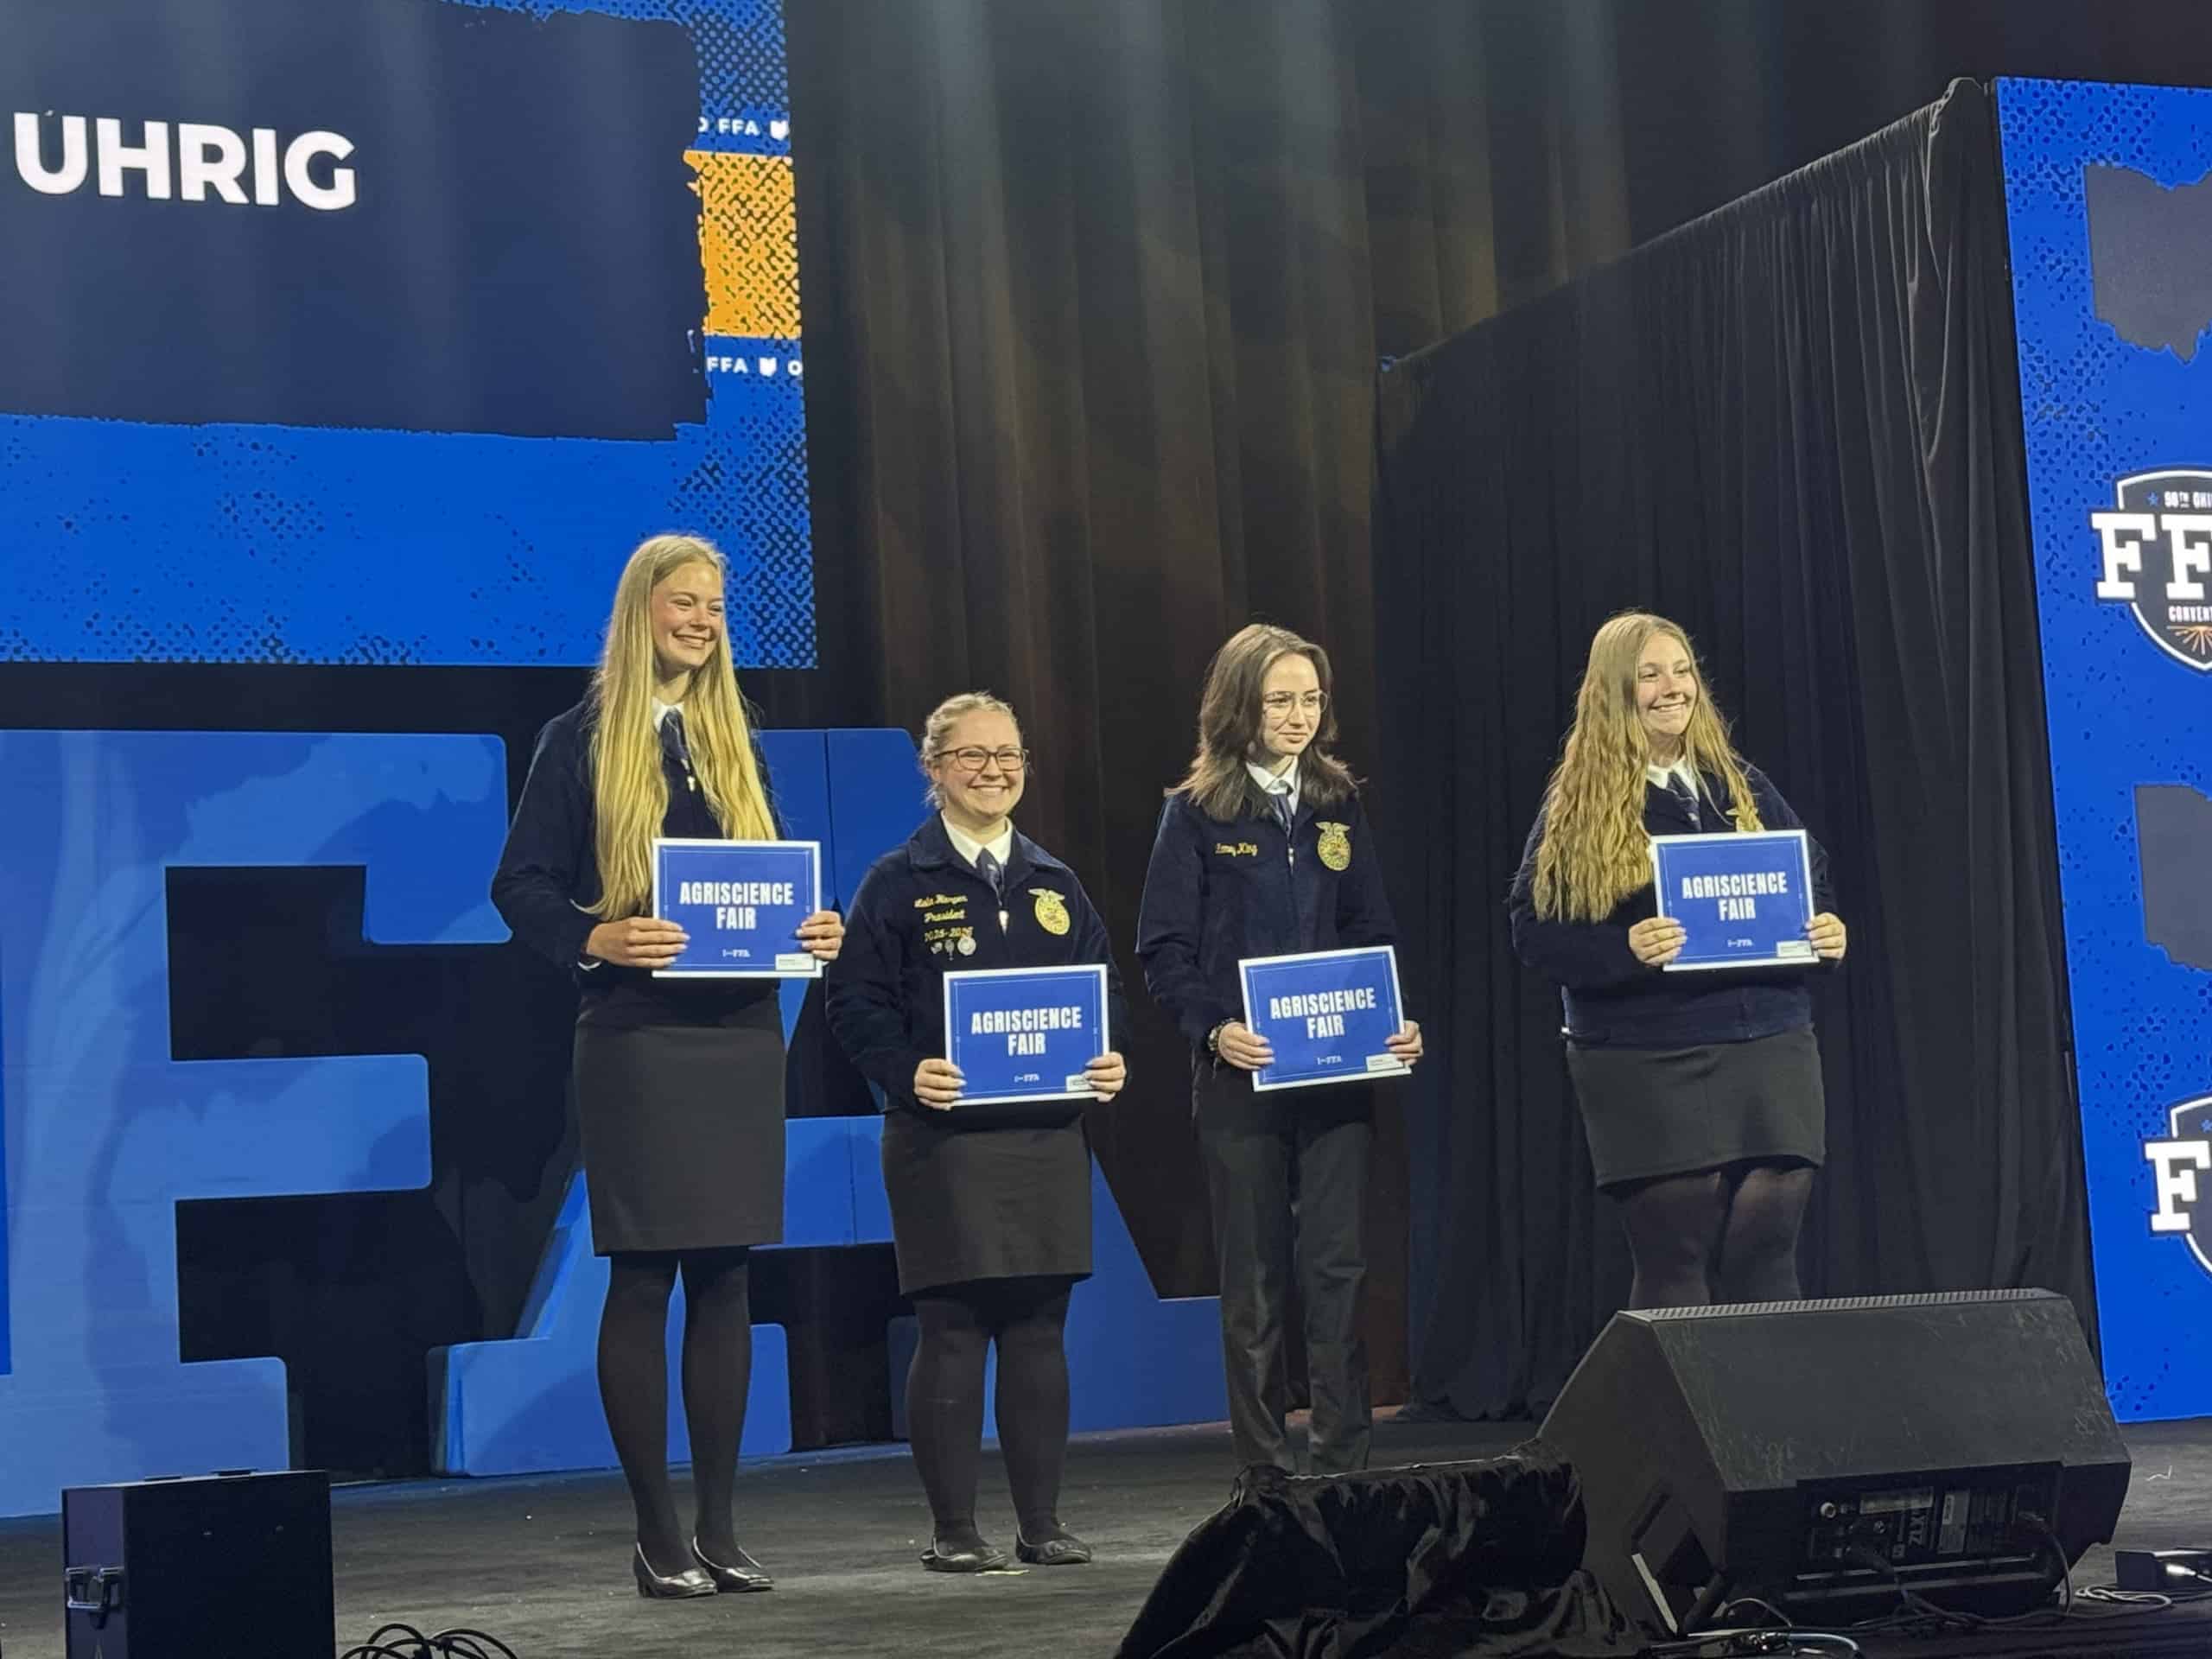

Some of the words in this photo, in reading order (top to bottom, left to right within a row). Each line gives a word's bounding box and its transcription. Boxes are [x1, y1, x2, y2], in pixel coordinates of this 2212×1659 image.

[718, 118, 760, 137] FFA
[13, 111, 357, 211] UHRIG
[706, 356, 748, 373] FFA
[2169, 606, 2212, 622] CONVEN
[679, 882, 795, 906] AGRISCIENCE
[1681, 872, 1788, 899] AGRISCIENCE
[716, 906, 757, 930] FAIR
[1719, 898, 1756, 921] FAIR
[1270, 988, 1376, 1020] AGRISCIENCE
[970, 1007, 1082, 1034] AGRISCIENCE
[1306, 1014, 1344, 1039] FAIR
[1007, 1033, 1046, 1056] FAIR
